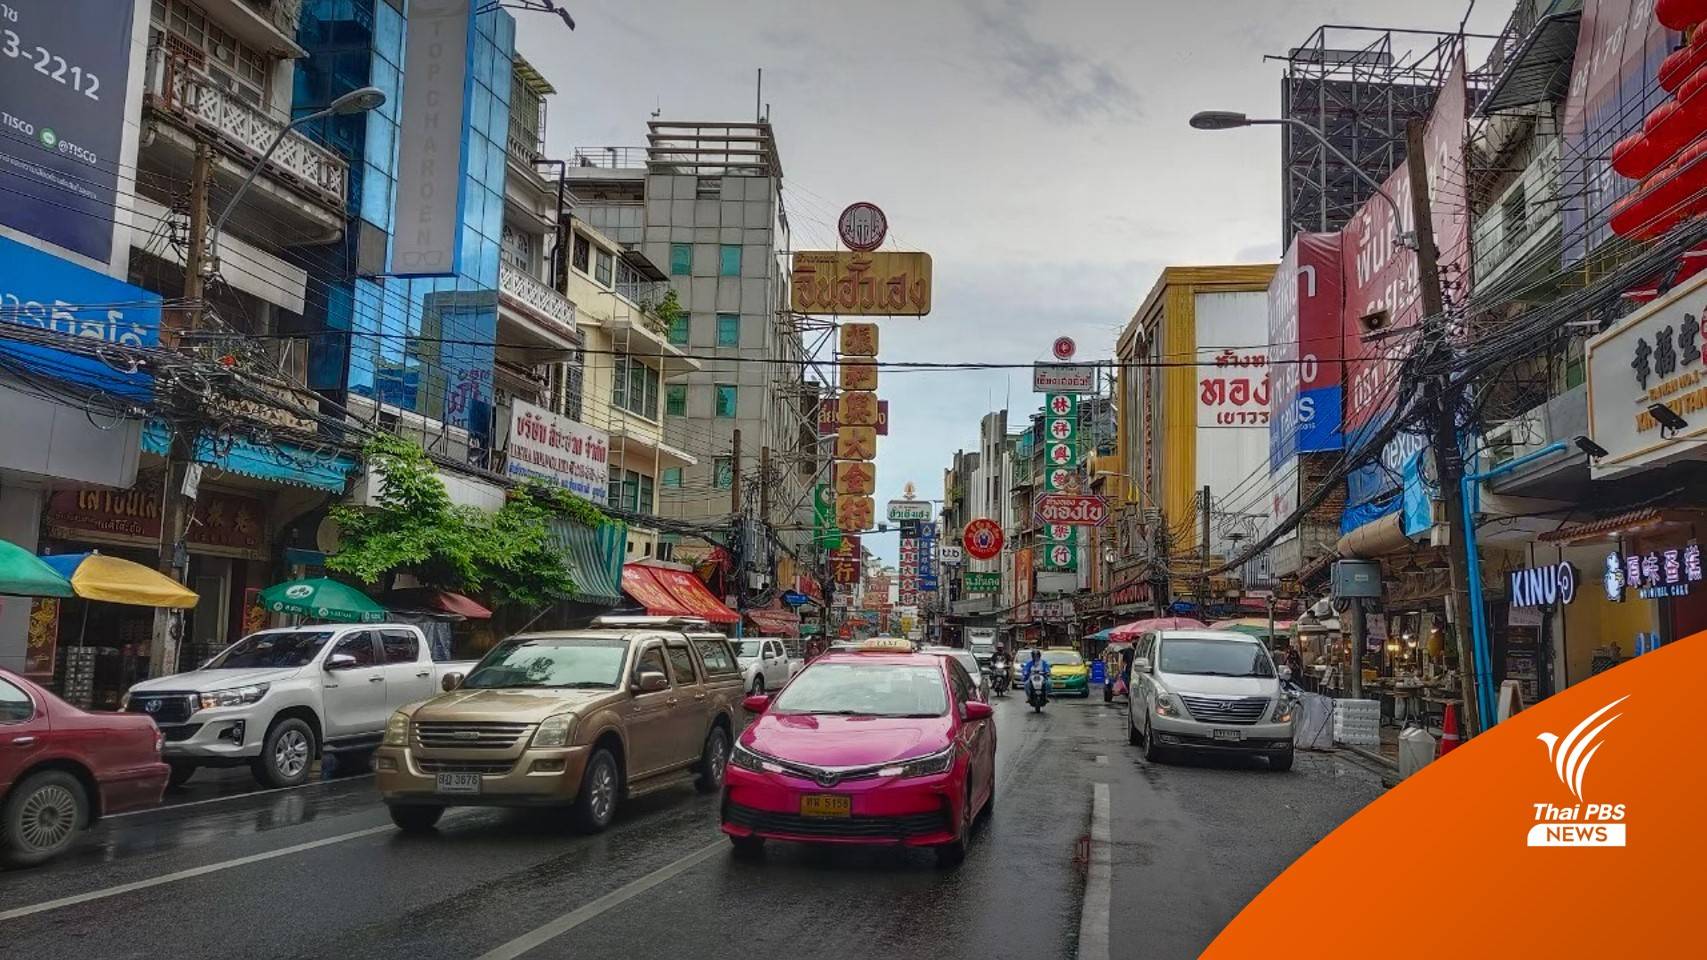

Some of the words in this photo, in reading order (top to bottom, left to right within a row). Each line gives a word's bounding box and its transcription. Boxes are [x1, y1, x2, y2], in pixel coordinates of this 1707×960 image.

[0, 29, 100, 100] 3-2212
[1, 111, 34, 136] TISCO
[58, 139, 97, 164] @TISCO
[0, 293, 147, 347] ารทิสโก้
[1215, 349, 1269, 368] ห้างท
[1631, 312, 1701, 390] 幸福堂
[1199, 373, 1270, 406] ทอง
[1042, 500, 1103, 521] ทองใบ
